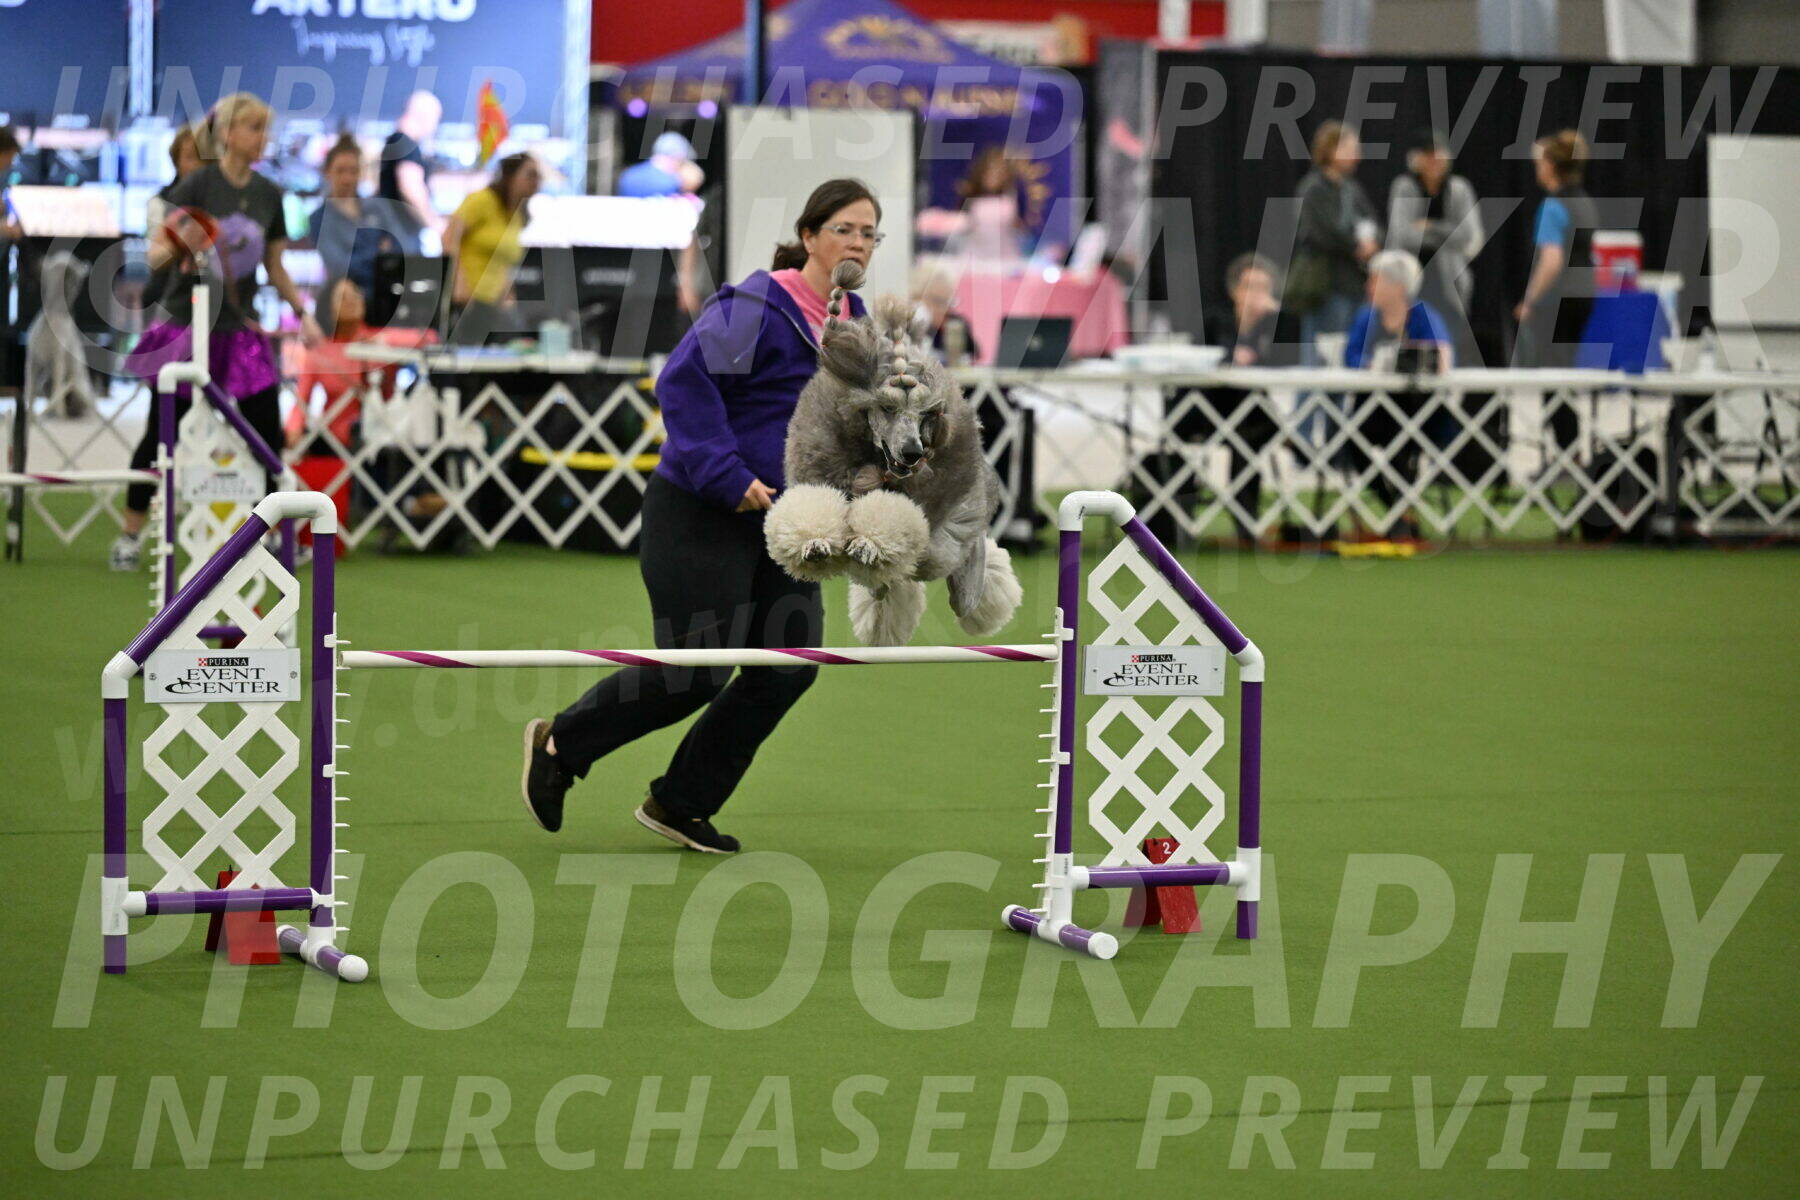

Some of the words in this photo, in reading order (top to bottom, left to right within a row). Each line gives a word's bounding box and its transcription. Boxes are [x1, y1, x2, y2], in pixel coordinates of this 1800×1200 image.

[208, 658, 247, 666] PURINA
[1121, 663, 1187, 674] EVENT
[186, 667, 265, 681] EVENT
[1103, 674, 1199, 687] CENTER
[165, 680, 281, 694] CENTER
[1162, 842, 1172, 855] 2
